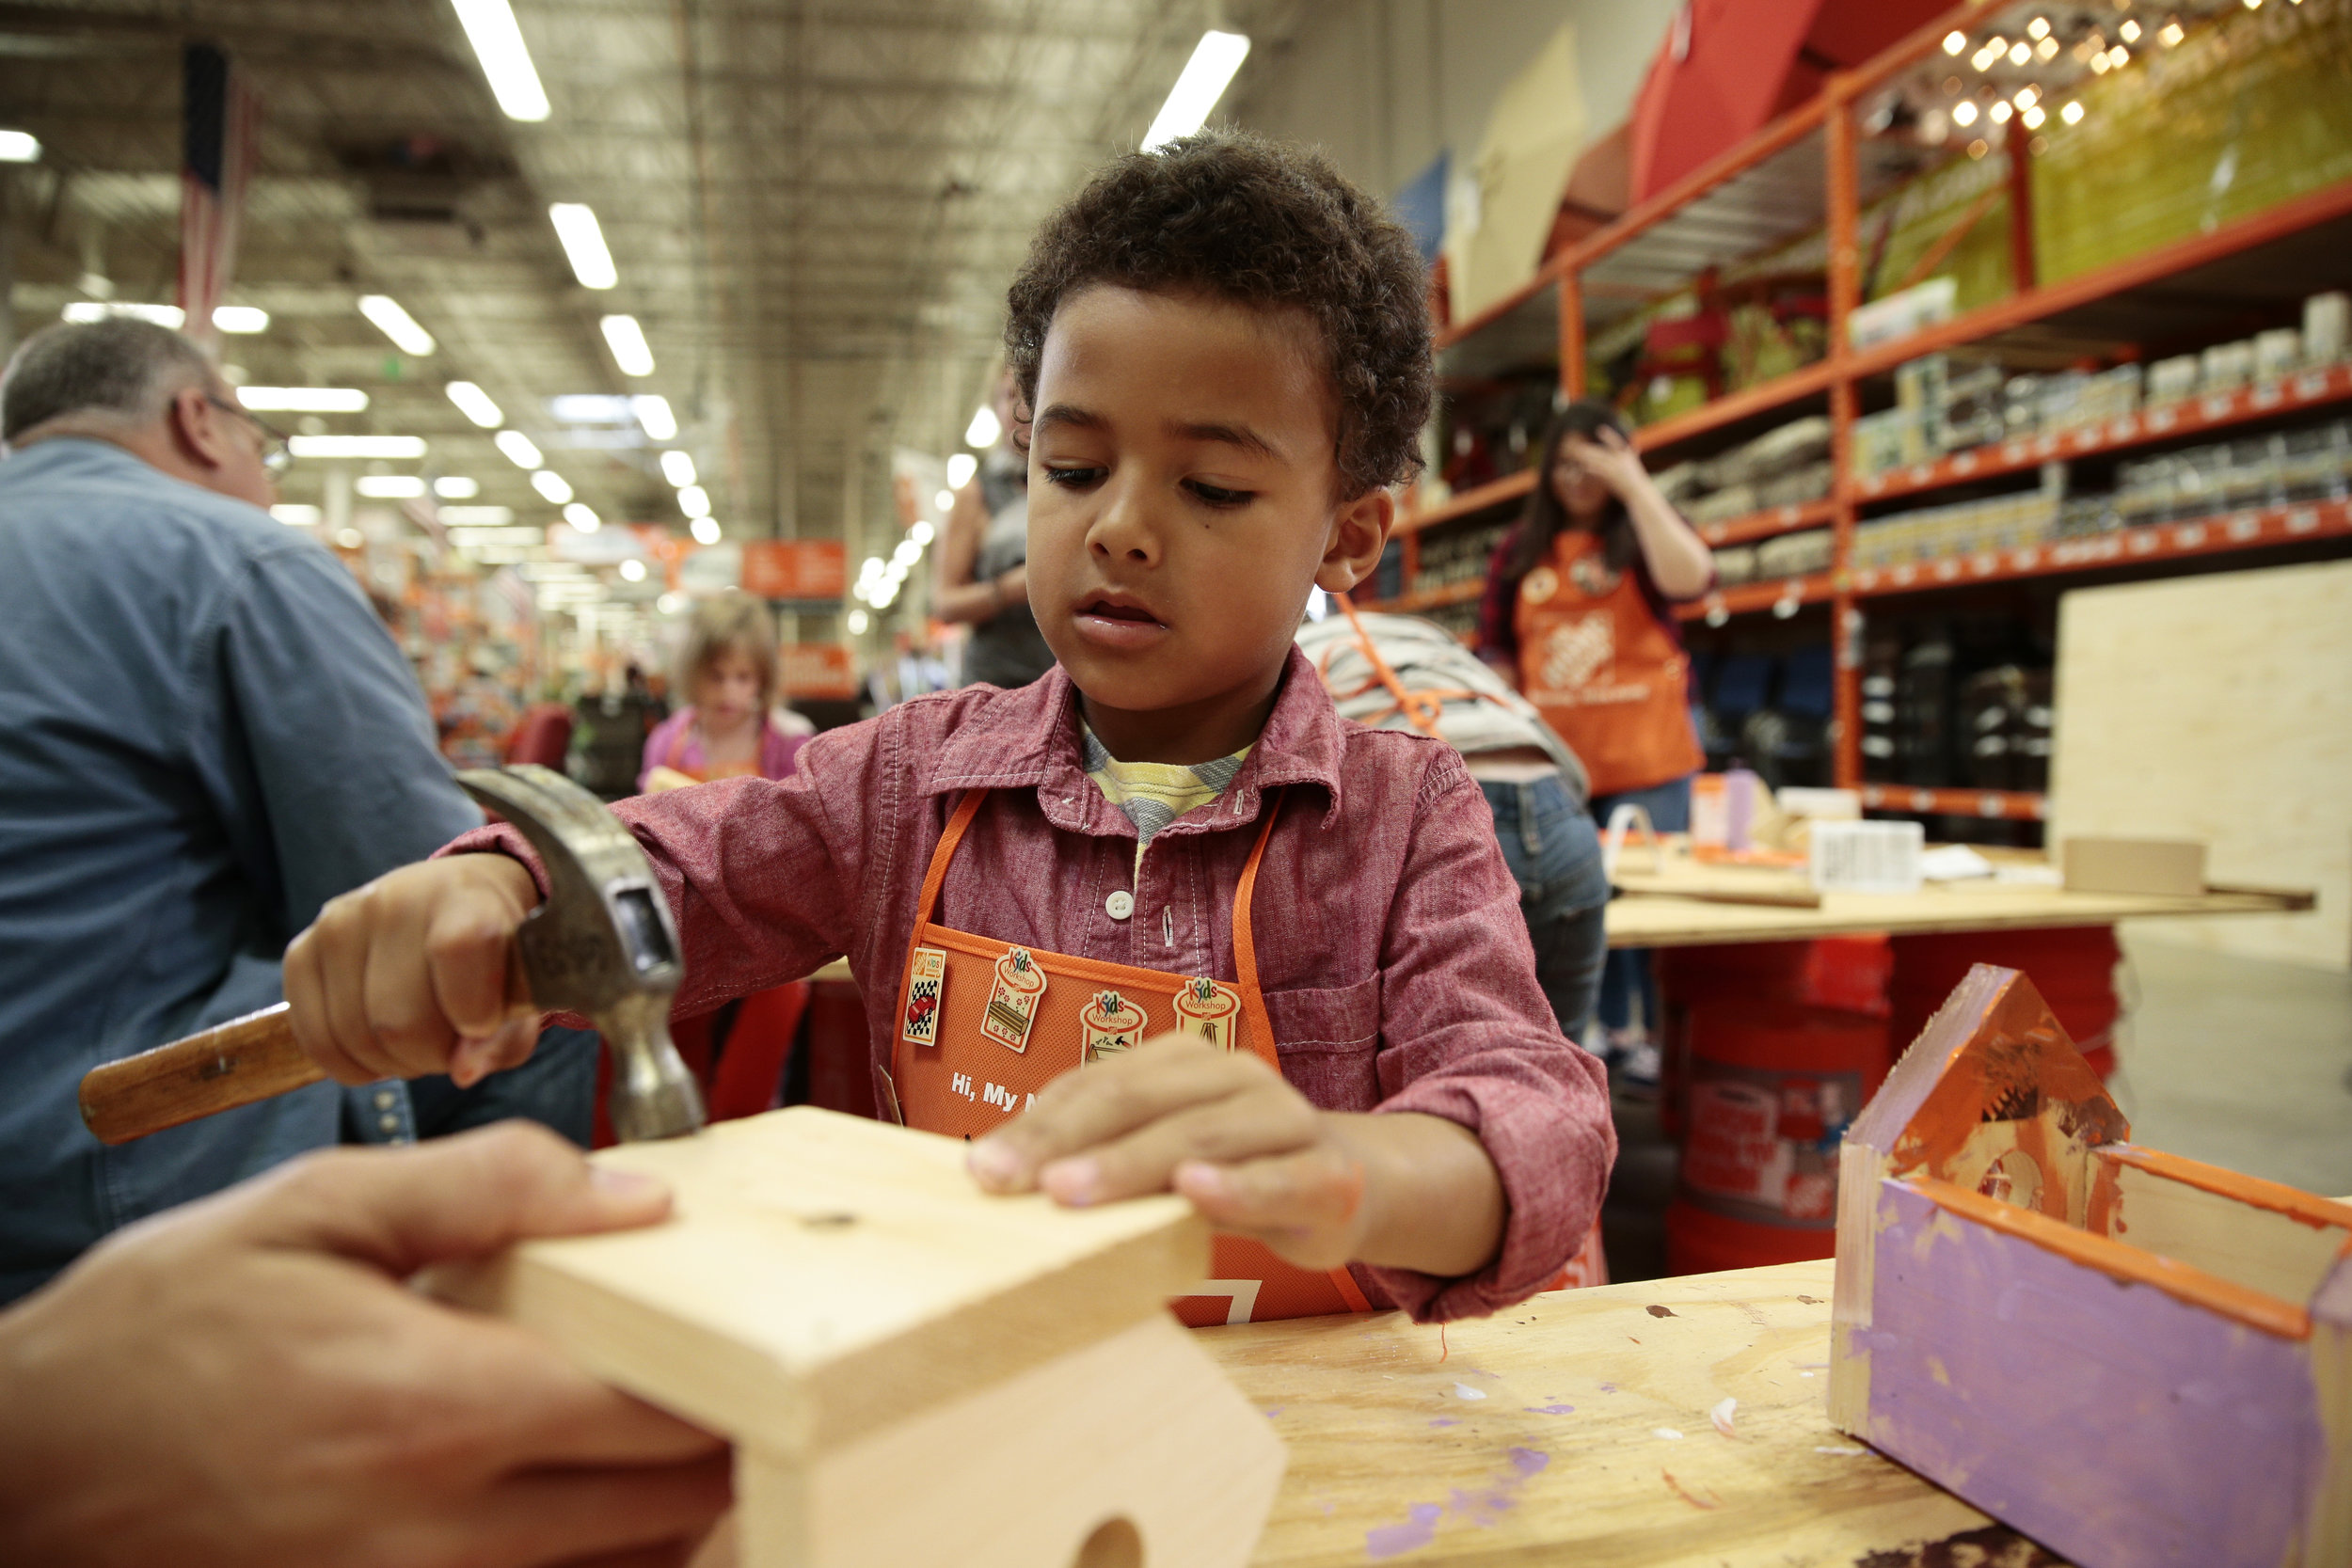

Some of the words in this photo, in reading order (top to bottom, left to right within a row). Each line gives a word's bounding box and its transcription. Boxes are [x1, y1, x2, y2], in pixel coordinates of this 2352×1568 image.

[1009, 951, 1032, 973] Kids
[1004, 966, 1035, 988] Workshop
[1188, 980, 1217, 1003] Kids
[1096, 994, 1124, 1017] Kids
[1185, 1000, 1226, 1011] Workshop
[1092, 1014, 1133, 1026] Workshop
[952, 1071, 976, 1102] Hi,
[983, 1082, 1018, 1112] My
